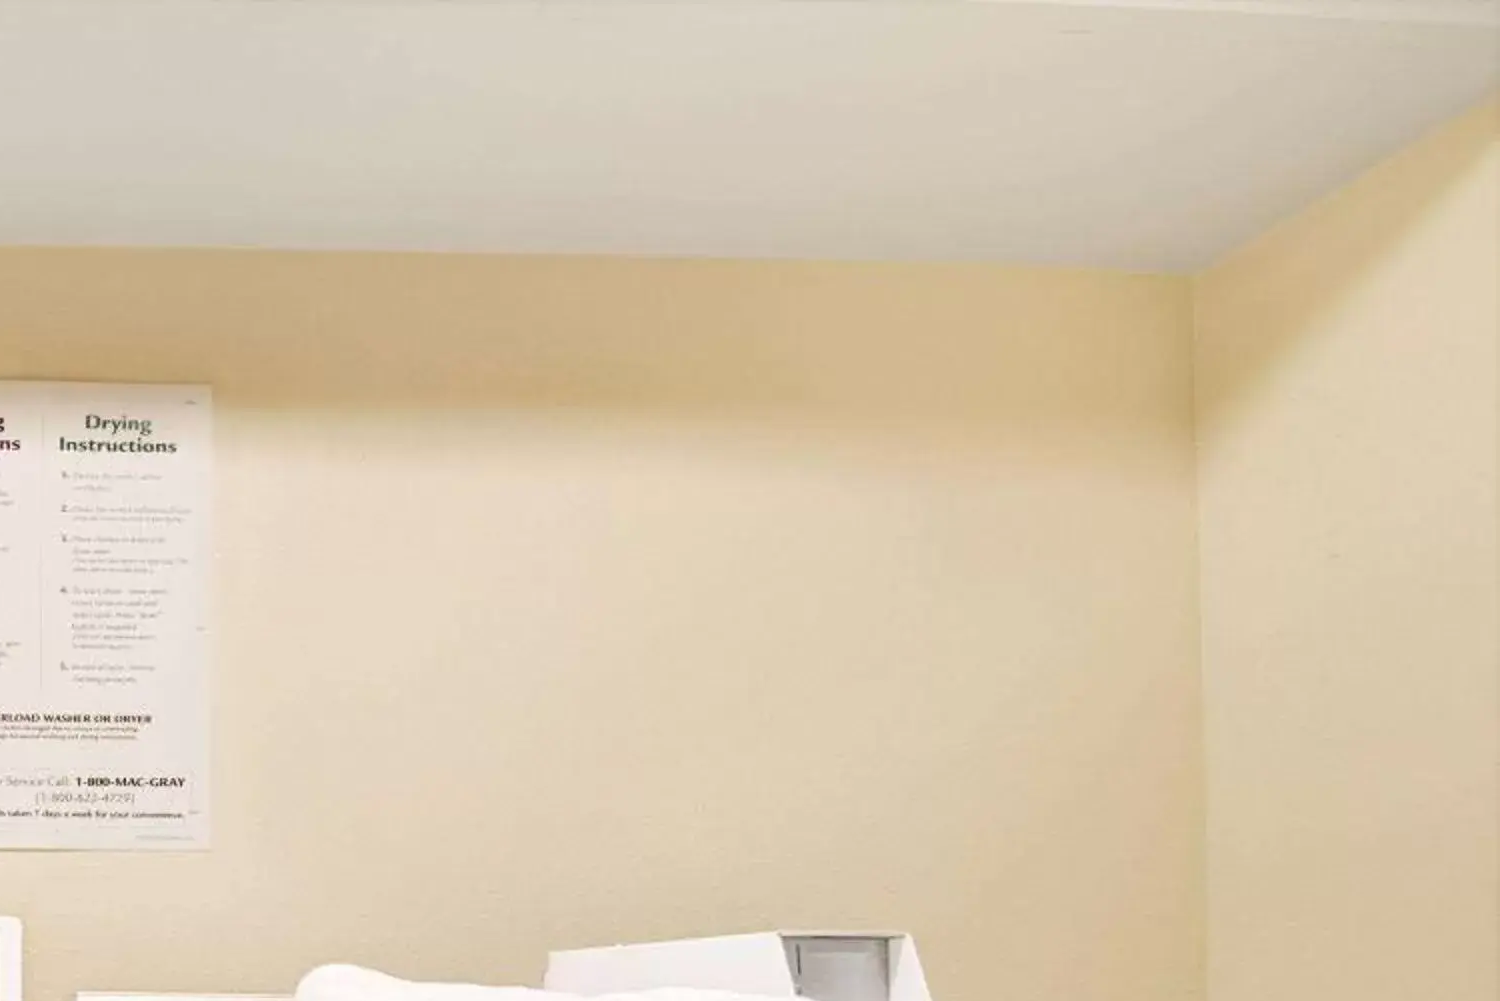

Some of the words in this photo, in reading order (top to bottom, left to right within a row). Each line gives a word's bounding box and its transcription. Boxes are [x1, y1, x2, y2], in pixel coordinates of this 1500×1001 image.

[85, 413, 152, 435] Drying
[59, 436, 177, 454] Instructions
[43, 714, 91, 722] WASHER
[93, 714, 111, 723] OR
[114, 714, 152, 723] DRYER
[76, 776, 186, 787] 1-800-MAC-GRAY
